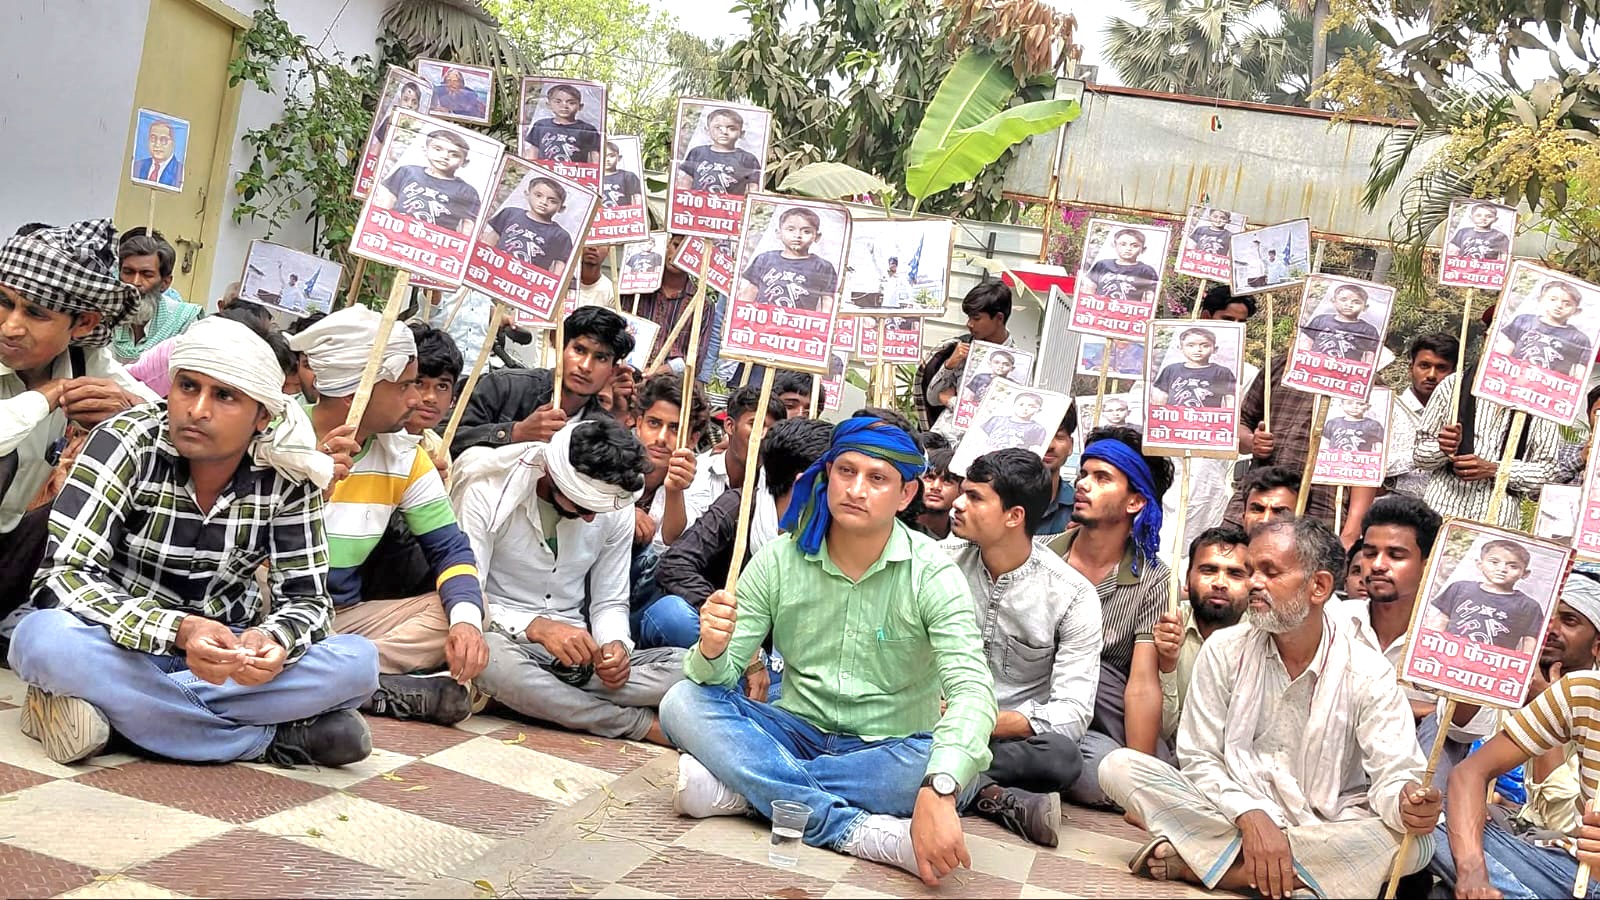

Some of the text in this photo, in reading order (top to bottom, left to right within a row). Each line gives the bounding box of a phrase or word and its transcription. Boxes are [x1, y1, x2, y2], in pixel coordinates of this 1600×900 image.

[706, 193, 742, 215] फैज़ा
[673, 211, 734, 229] को न्याय
[362, 231, 463, 275] को न्याय दो
[682, 254, 700, 268] को
[1444, 269, 1460, 280] को
[468, 265, 492, 284] को
[492, 275, 532, 301] न्याय
[532, 291, 553, 309] दो
[1075, 312, 1147, 333] को न्याय दो
[731, 327, 826, 356] को न्याय दो
[864, 330, 877, 340] मो
[1289, 368, 1367, 395] को न्याय दो
[1483, 376, 1576, 417] को न्याय दो
[1150, 425, 1233, 443] को न्याय दो
[1413, 657, 1524, 697] को न्याय दो
